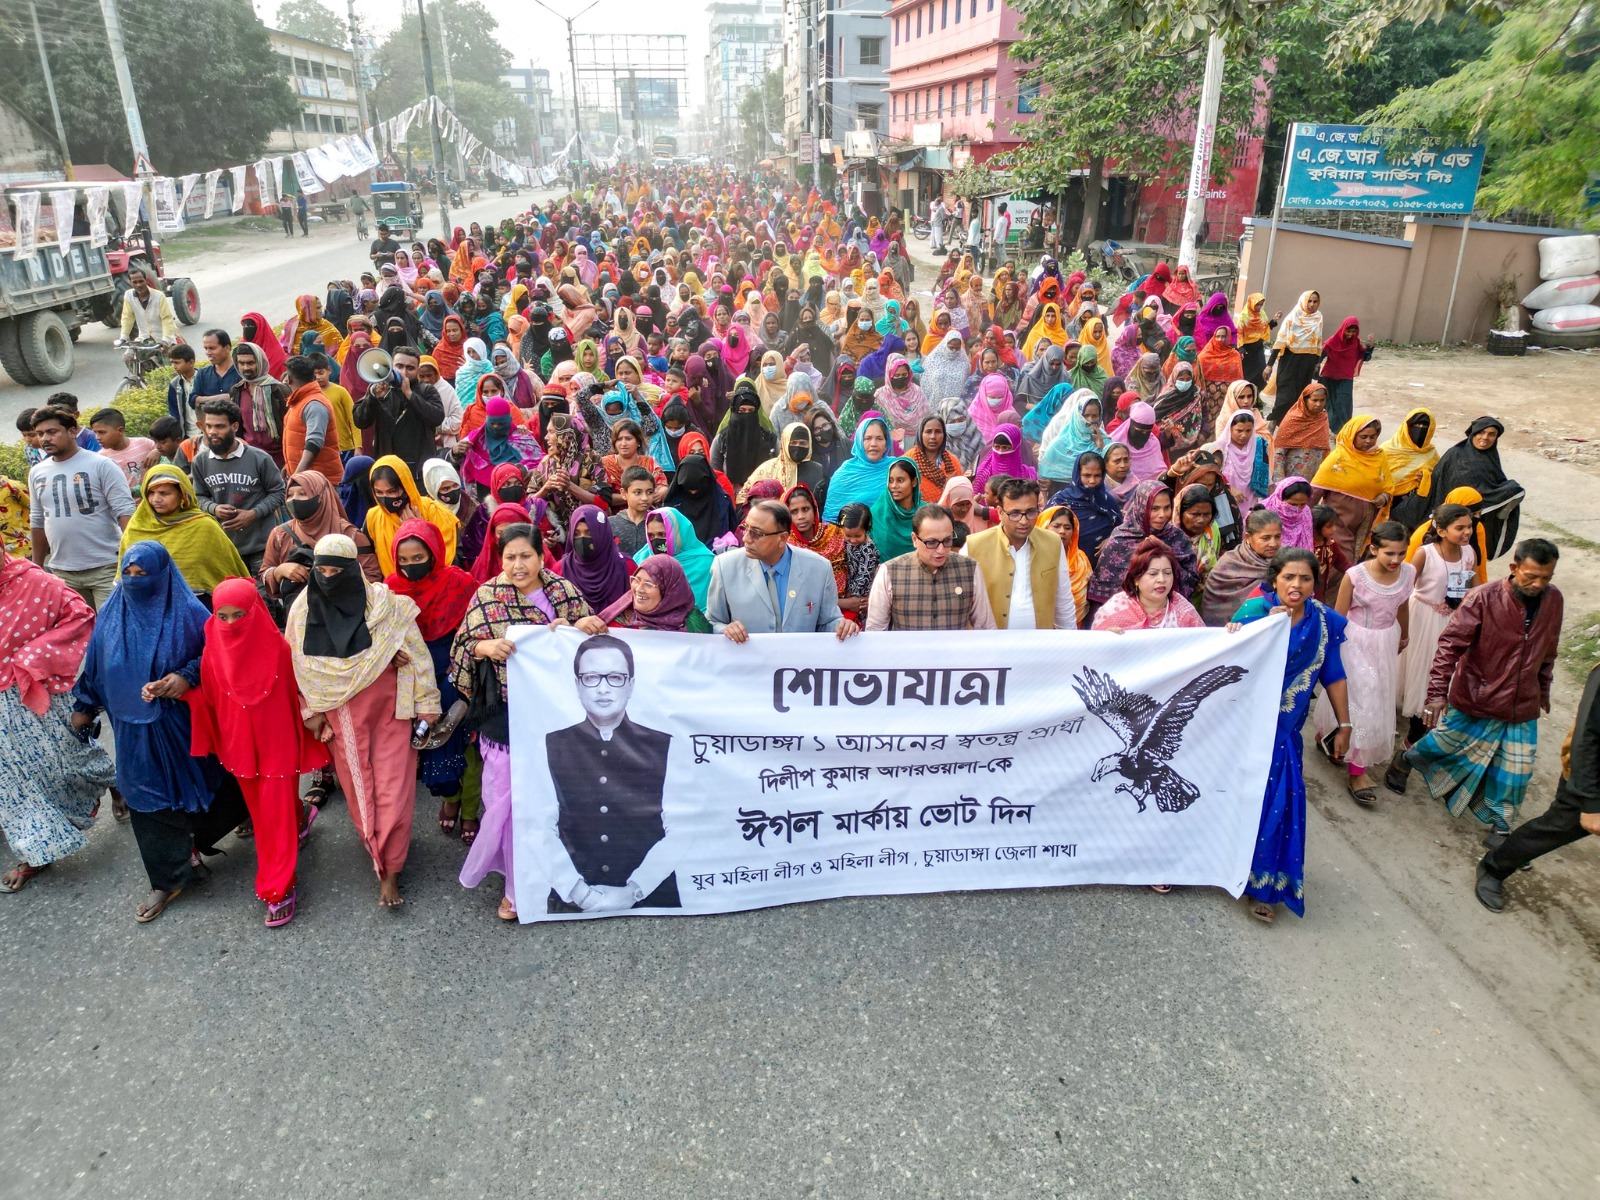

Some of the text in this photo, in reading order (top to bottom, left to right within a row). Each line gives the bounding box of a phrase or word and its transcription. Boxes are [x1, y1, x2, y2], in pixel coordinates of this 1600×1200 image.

[1297, 148, 1380, 166] এ.জে.আর
[1307, 166, 1453, 183] কুরিয়ার সার্ভিস লিঃ
[204, 473, 258, 487] PREMIUM
[773, 668, 1012, 713] শোভাযাত্রা
[690, 734, 804, 764] চুয়াডাঙ্গা
[813, 736, 826, 751] ১
[836, 734, 948, 752] আসনের
[956, 731, 1023, 750] স্বতন্ত্র
[758, 756, 1014, 793] দিলীপ কুমার আগরওয়ালা-কে
[736, 794, 1036, 847] ঈগল মার্কায় ভোট দিন
[691, 873, 715, 890] যুব
[720, 866, 769, 884] মহিলা
[773, 861, 806, 879] লীগ
[810, 862, 823, 874] ও
[827, 853, 874, 871] মহিলা
[923, 847, 990, 867] চুয়াডাঙ্গা
[995, 845, 1037, 861] জেলা
[1042, 843, 1078, 858] শাখা
